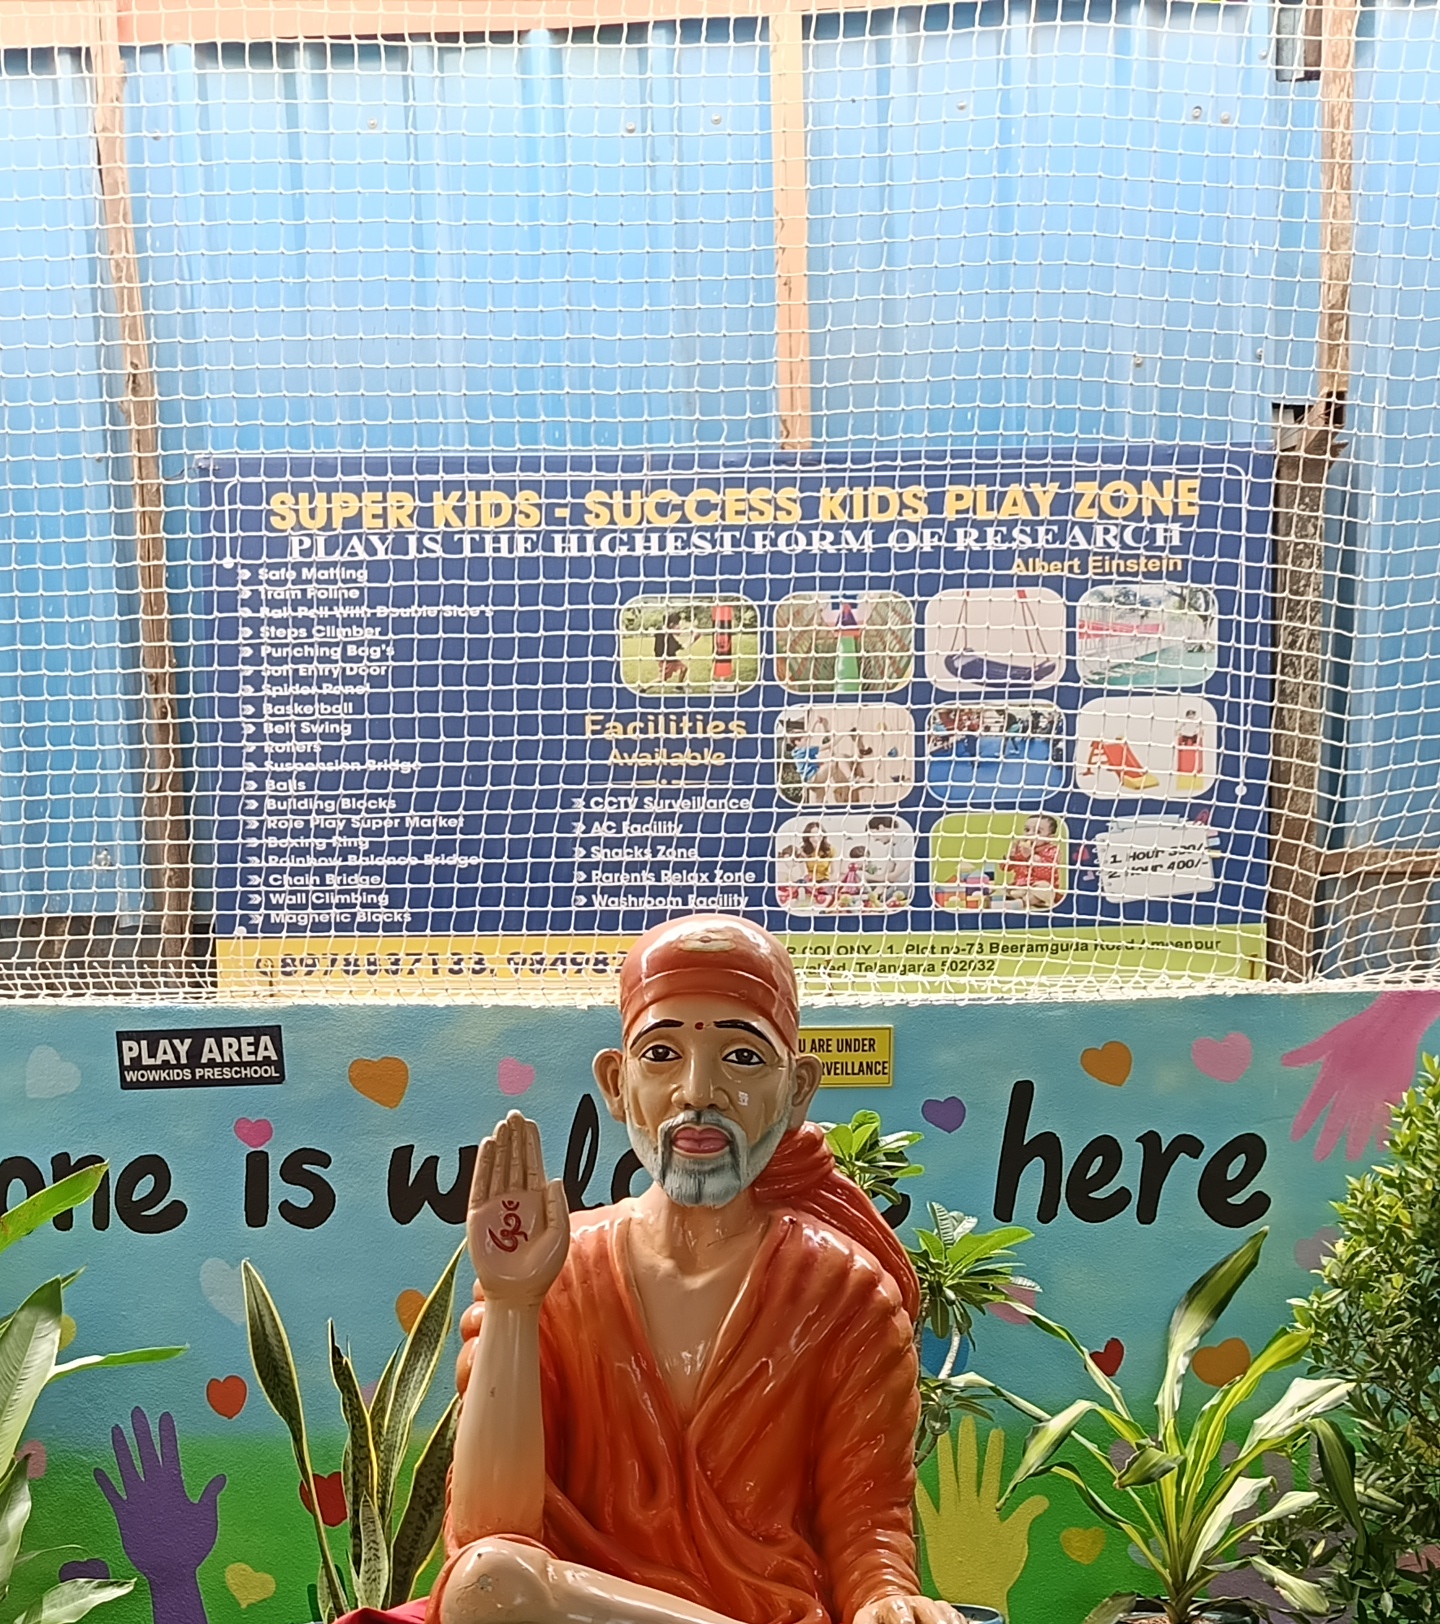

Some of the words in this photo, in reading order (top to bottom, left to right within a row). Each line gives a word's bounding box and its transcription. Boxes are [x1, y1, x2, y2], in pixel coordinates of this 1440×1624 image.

[270, 491, 415, 530] SUPER
[433, 490, 541, 528] KIDS
[584, 487, 802, 527] SUCCESS
[820, 485, 928, 523] KIDS
[945, 482, 1060, 522] PLAY
[1074, 479, 1200, 518] ZONE
[290, 533, 395, 559] PLAY
[405, 534, 443, 557] IS
[454, 533, 539, 557] THE
[550, 531, 740, 557] HIGHEST
[752, 529, 876, 555] FORM
[888, 528, 944, 553] OF
[954, 523, 1183, 551] RESEARCH
[1011, 557, 1081, 574] Albert
[1090, 556, 1183, 573] Einstein
[258, 568, 296, 580] Safe
[301, 567, 368, 582] Matting
[259, 588, 301, 600] Tram
[307, 588, 360, 600] Poline
[259, 626, 307, 640] Steps
[312, 625, 381, 637] Climber
[260, 645, 340, 659] Punching
[346, 644, 395, 658] Bag's
[346, 666, 387, 676] Door
[263, 703, 353, 715] Basketball
[301, 722, 352, 736] Swing
[585, 714, 747, 740] Facilities
[607, 748, 726, 766] Available
[266, 780, 306, 791] Balls
[267, 798, 335, 811] Building
[341, 798, 396, 809] Blocks
[590, 797, 638, 809] CCTV
[644, 796, 751, 809] Surveillance
[267, 818, 304, 829] Role
[310, 818, 344, 832] Play
[350, 817, 400, 831] Super
[405, 816, 464, 828] Market
[591, 821, 617, 834] AC
[622, 821, 683, 835] Facility
[591, 846, 652, 858] Snacks
[657, 846, 698, 858] Zone
[269, 874, 320, 886] Chain
[325, 874, 381, 888] Bridge
[592, 870, 655, 883] Parents
[661, 870, 709, 883] Relax
[714, 869, 756, 882] Zone
[269, 893, 306, 904] Wall
[311, 892, 389, 906] Climbing
[592, 894, 682, 907] Washroom
[688, 893, 749, 908] Facility
[270, 912, 351, 925] Magnetic
[357, 911, 412, 923] Blocks
[990, 940, 1088, 954] Beeramguda
[856, 961, 935, 976] Telangana
[122, 1038, 192, 1066] PLAY
[201, 1036, 278, 1063] AREA
[809, 1038, 833, 1053] ARE
[836, 1038, 876, 1053] UNDER
[125, 1069, 192, 1082] WOWKIDS
[195, 1066, 280, 1080] PRESCHOOL
[821, 1061, 888, 1076] RVEILLANCE
[243, 1146, 337, 1230] is
[993, 1080, 1271, 1229] here
